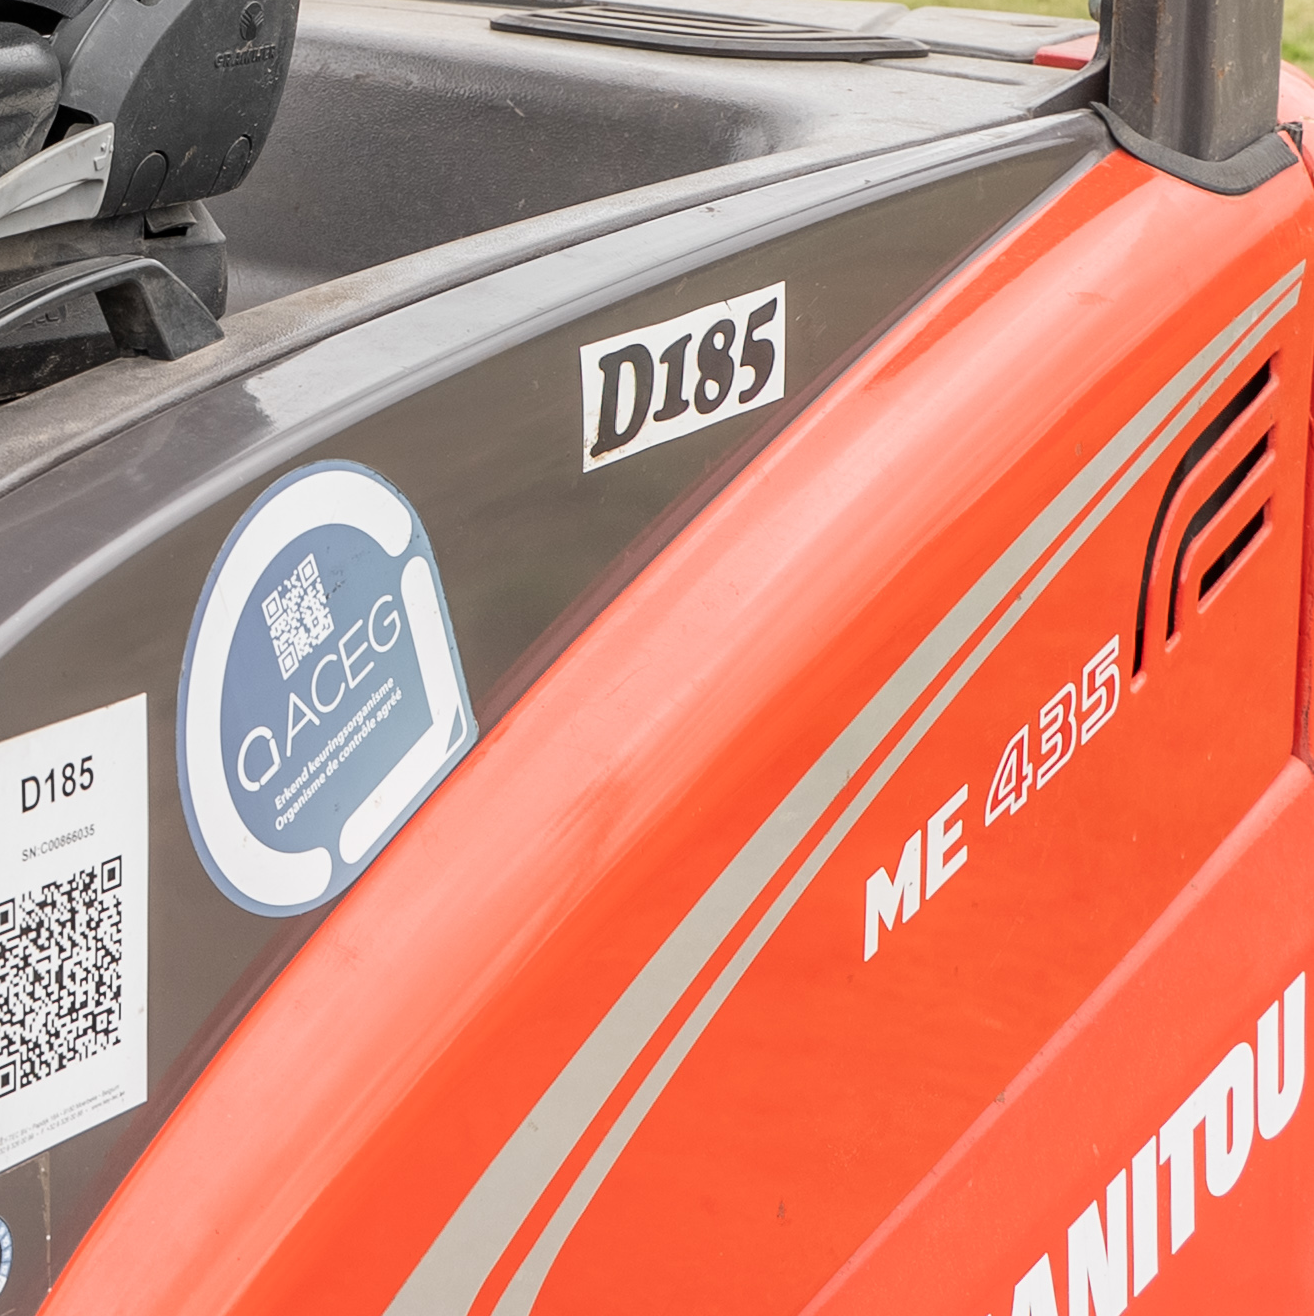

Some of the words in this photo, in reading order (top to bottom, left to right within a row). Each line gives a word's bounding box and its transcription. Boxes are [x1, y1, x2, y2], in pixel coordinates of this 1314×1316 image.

[589, 297, 778, 459] D185
[20, 754, 94, 814] D185
[274, 768, 310, 811] Erkend
[307, 677, 395, 774] keuringsorganisme
[275, 771, 327, 831] Organisme
[324, 758, 341, 778] de
[337, 720, 377, 763] contrôle
[375, 686, 404, 723] agréé
[863, 782, 969, 963] ME
[984, 633, 1121, 828] 435
[985, 970, 1307, 1316] NITOU
